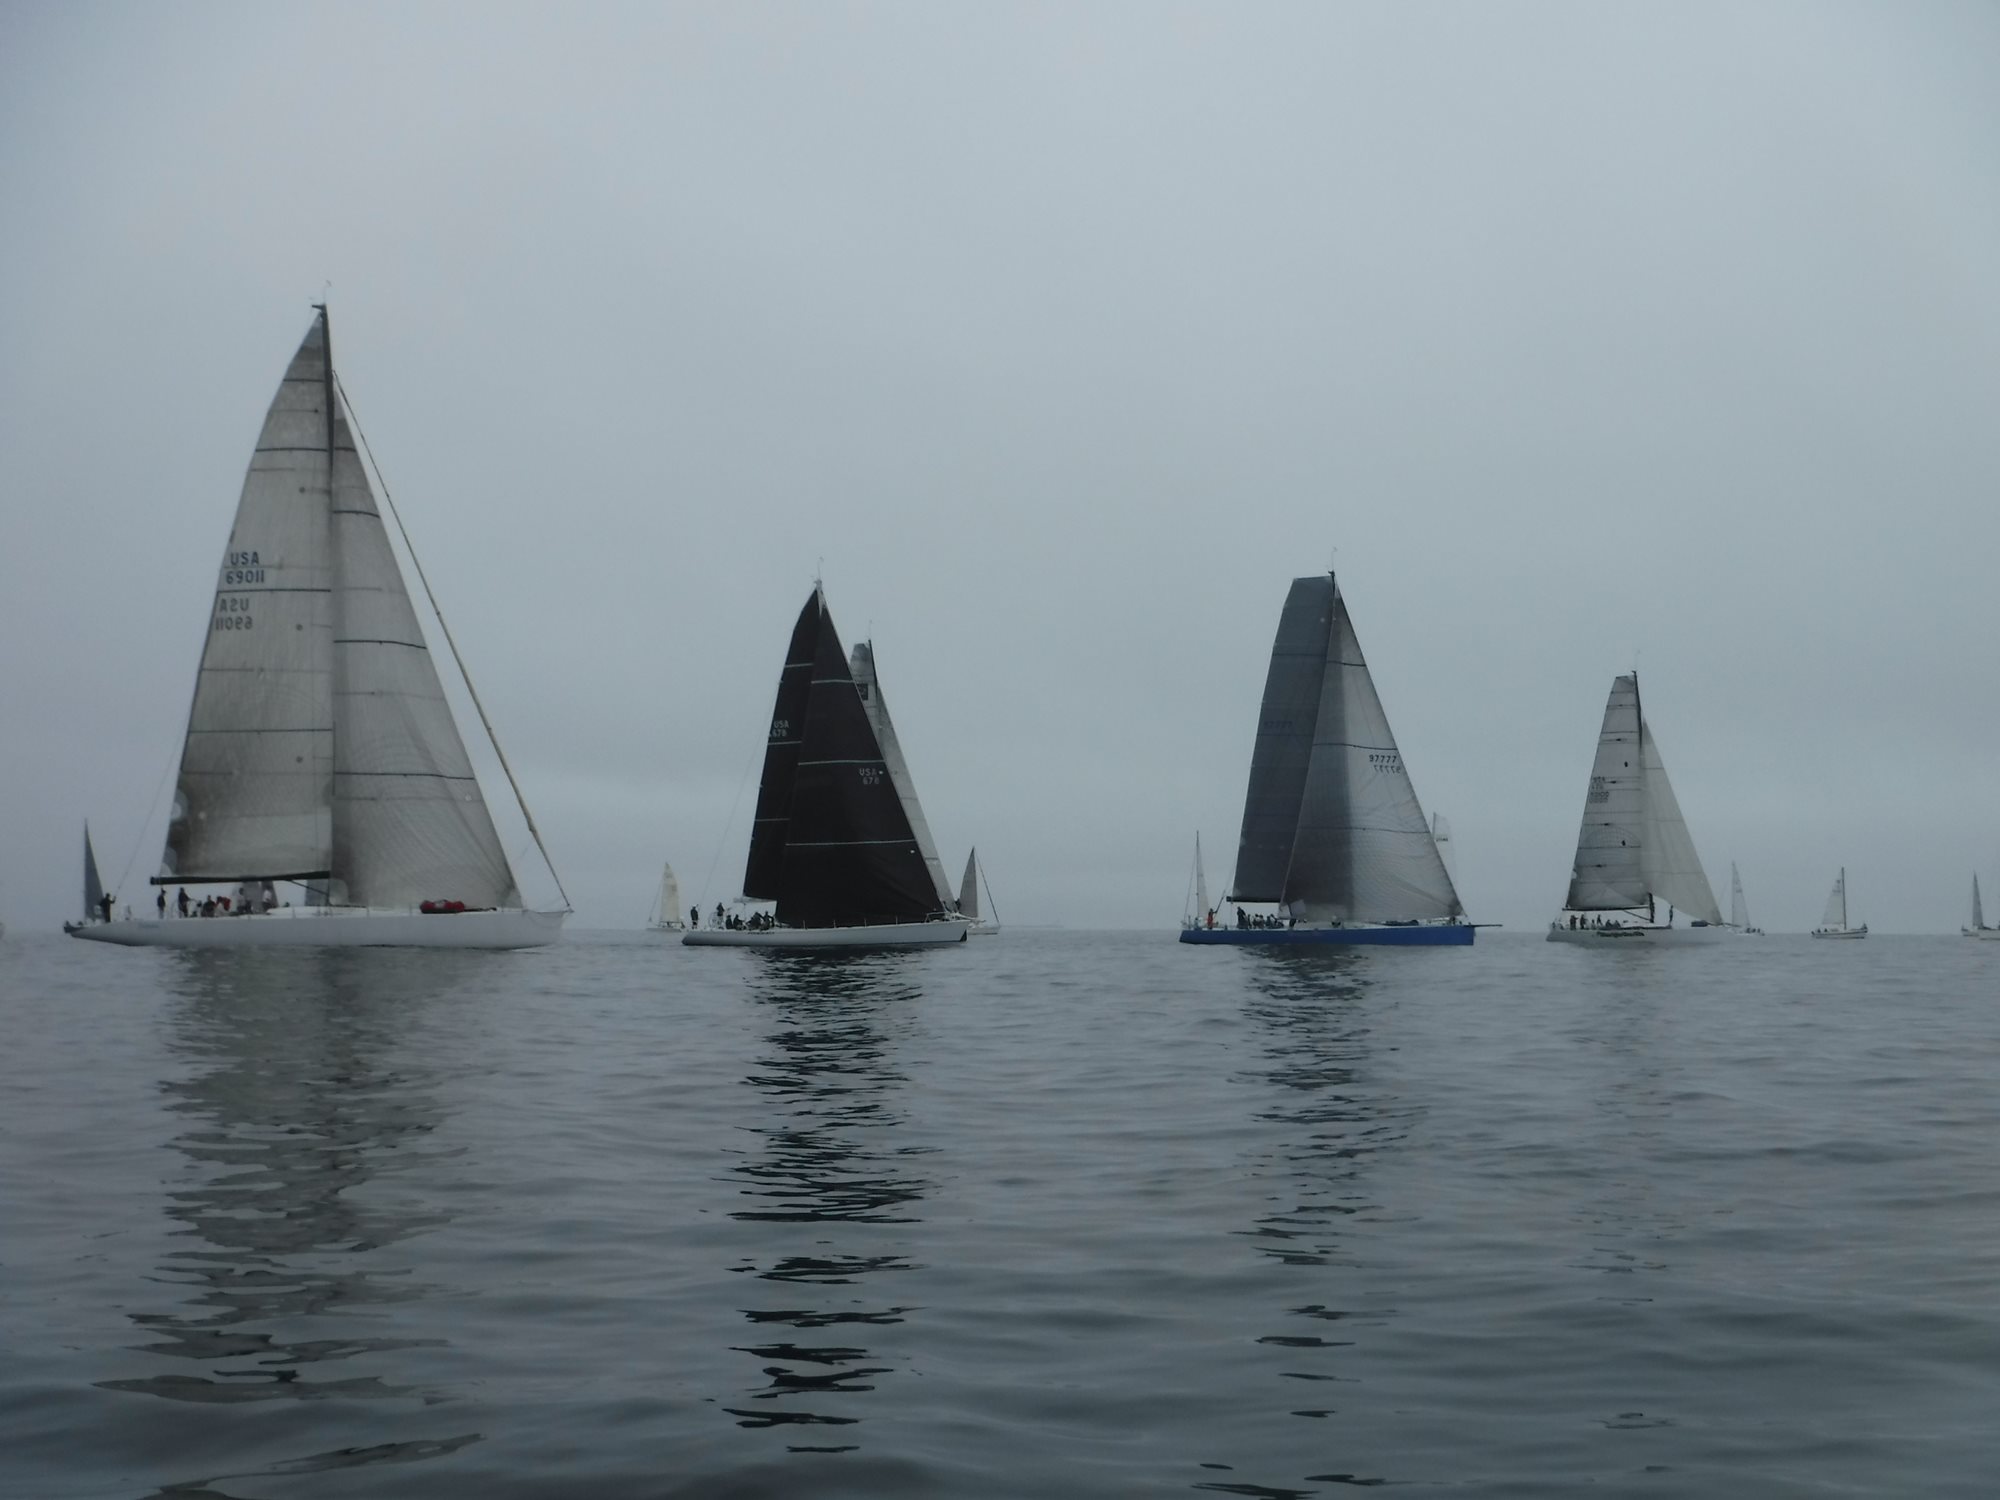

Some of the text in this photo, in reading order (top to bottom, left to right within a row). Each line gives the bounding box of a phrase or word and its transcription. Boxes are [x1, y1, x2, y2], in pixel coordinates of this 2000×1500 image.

[230, 551, 260, 566] USA
[226, 569, 265, 585] 69011
[774, 720, 789, 728] USA
[1369, 754, 1397, 763] 97777
[859, 768, 877, 776] USA
